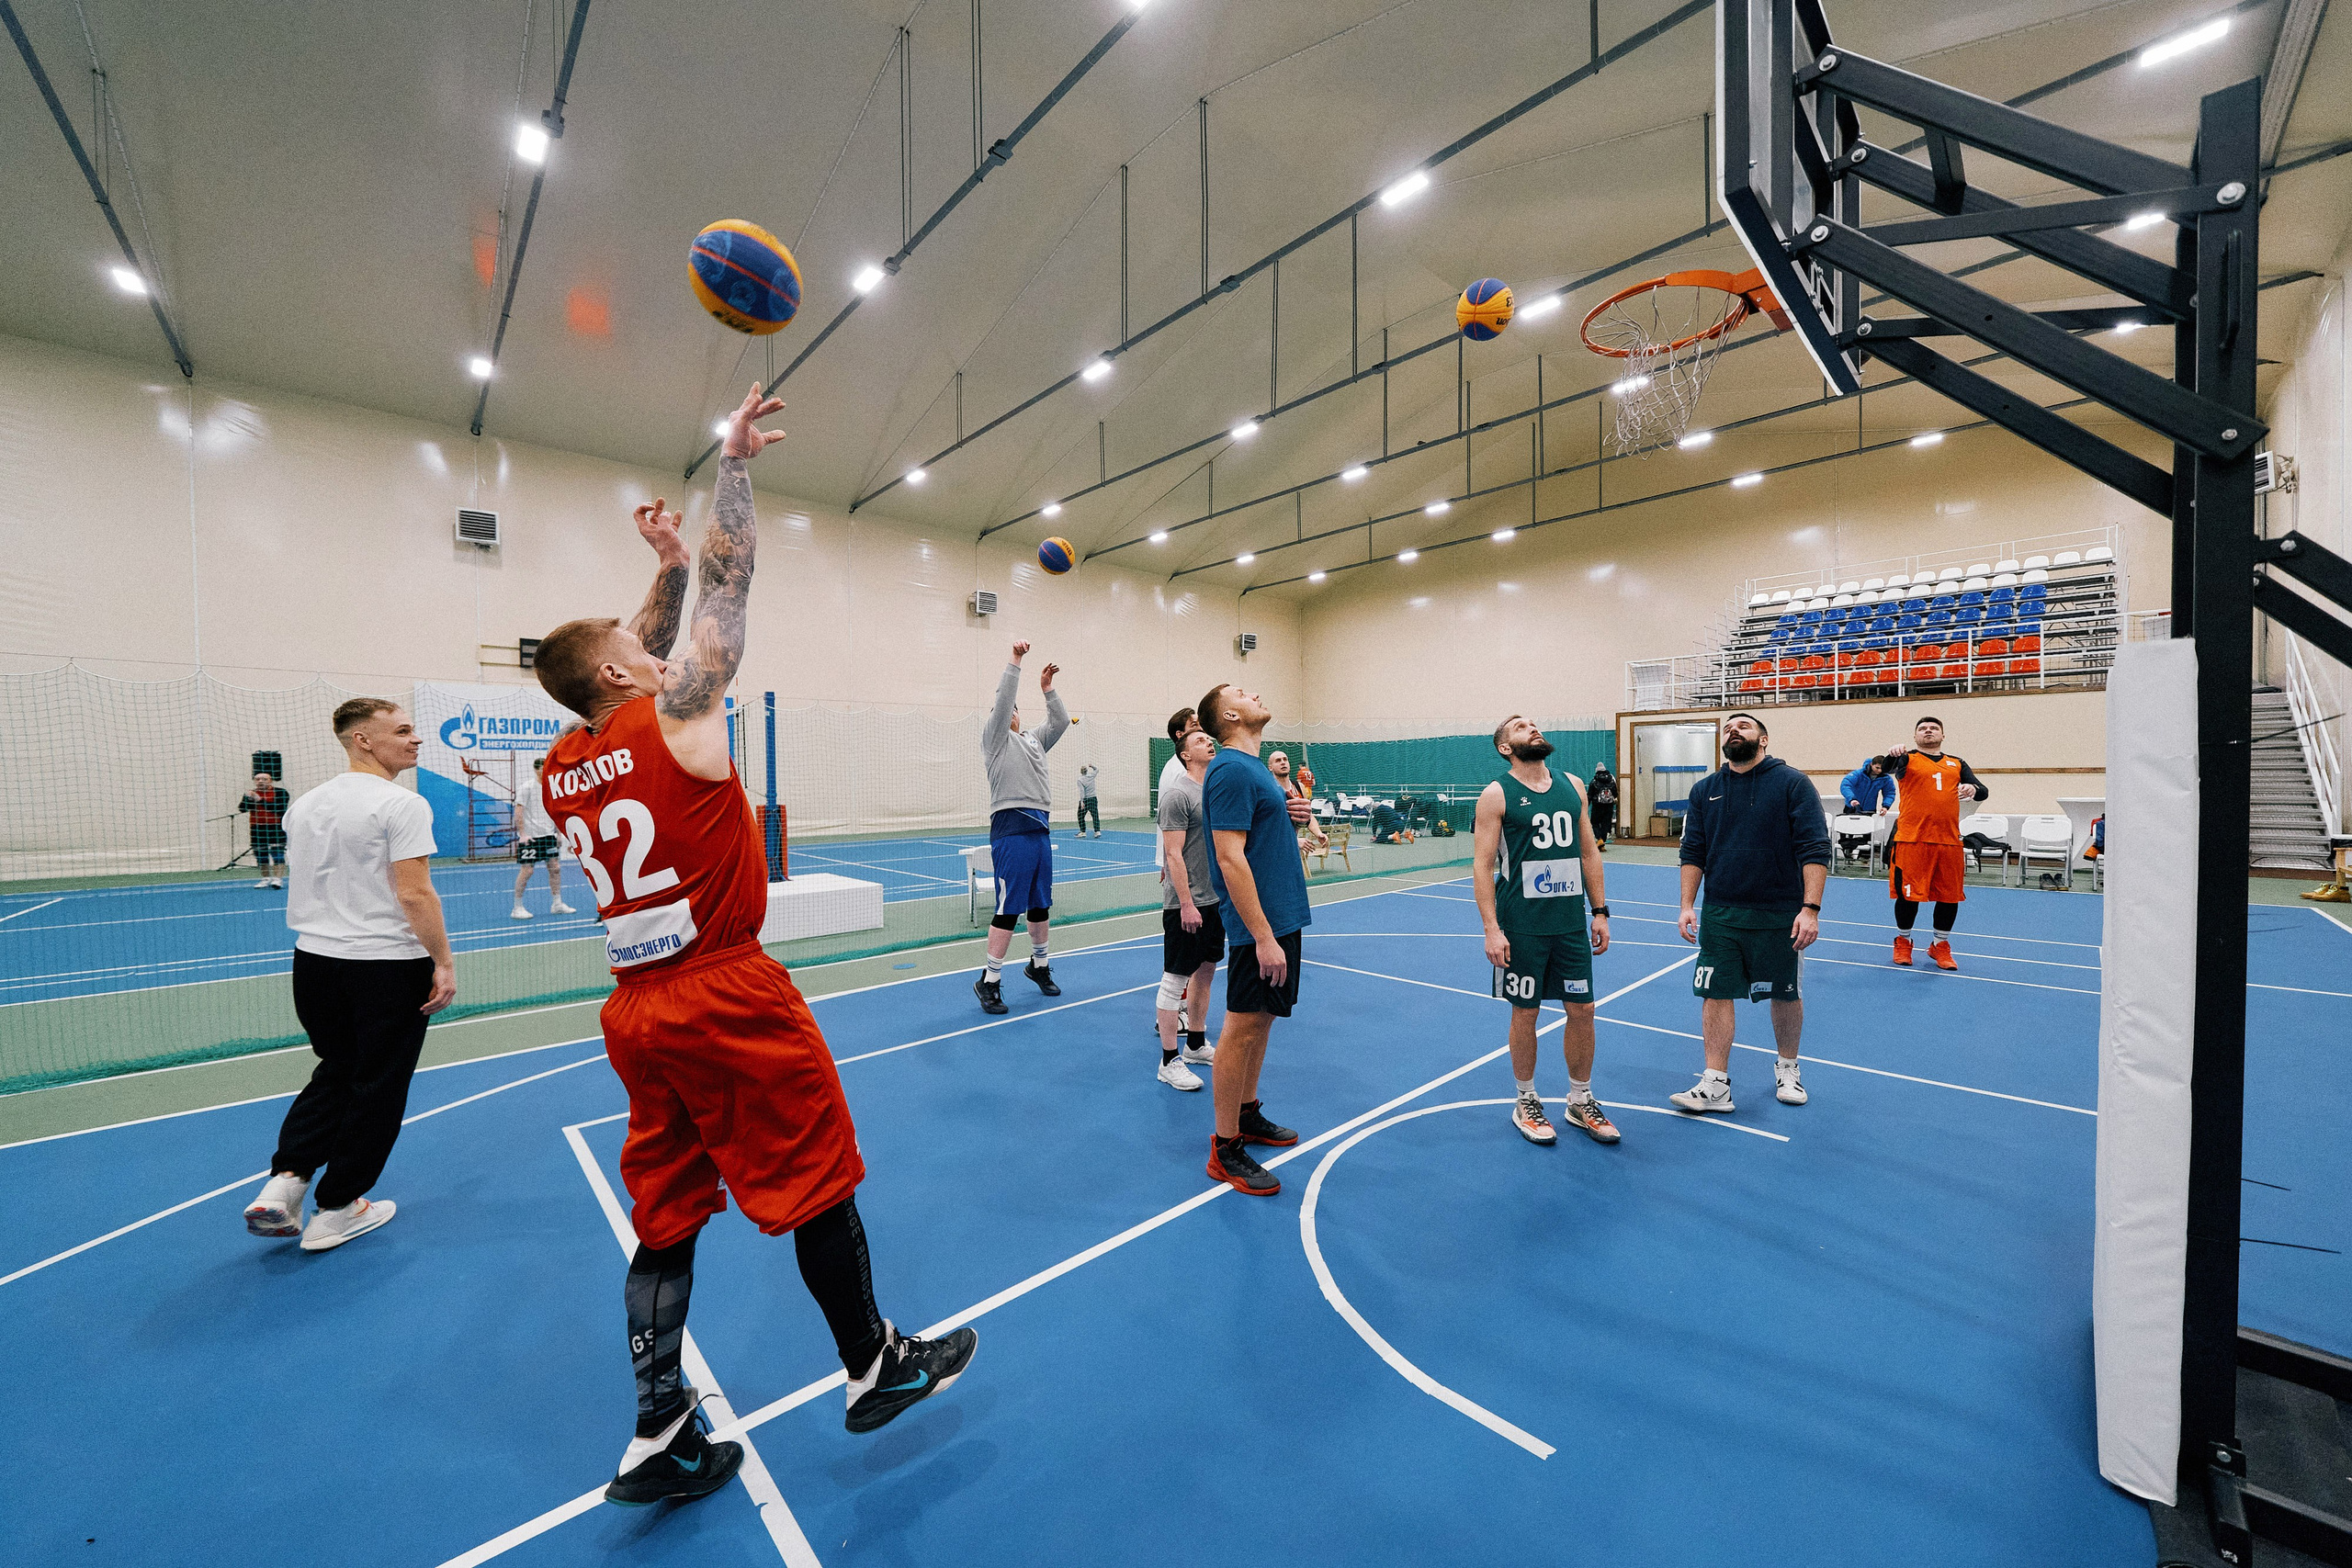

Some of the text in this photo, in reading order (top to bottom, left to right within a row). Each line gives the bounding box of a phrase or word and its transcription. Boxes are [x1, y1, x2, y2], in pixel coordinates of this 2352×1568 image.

[479, 716, 560, 735] ГАЗПРОМ
[548, 748, 634, 800] КОЗЛОВ
[1931, 772, 1942, 791] 1
[1532, 810, 1573, 850] 30
[521, 849, 537, 860] 22
[565, 798, 681, 908] 32
[1554, 881, 1574, 893] ОГК-2
[1904, 884, 1911, 897] 1
[619, 933, 682, 962] МОСЭНЕРГО
[1505, 972, 1535, 999] 30
[1693, 966, 1714, 989] 87
[856, 1245, 870, 1300] BRINGS
